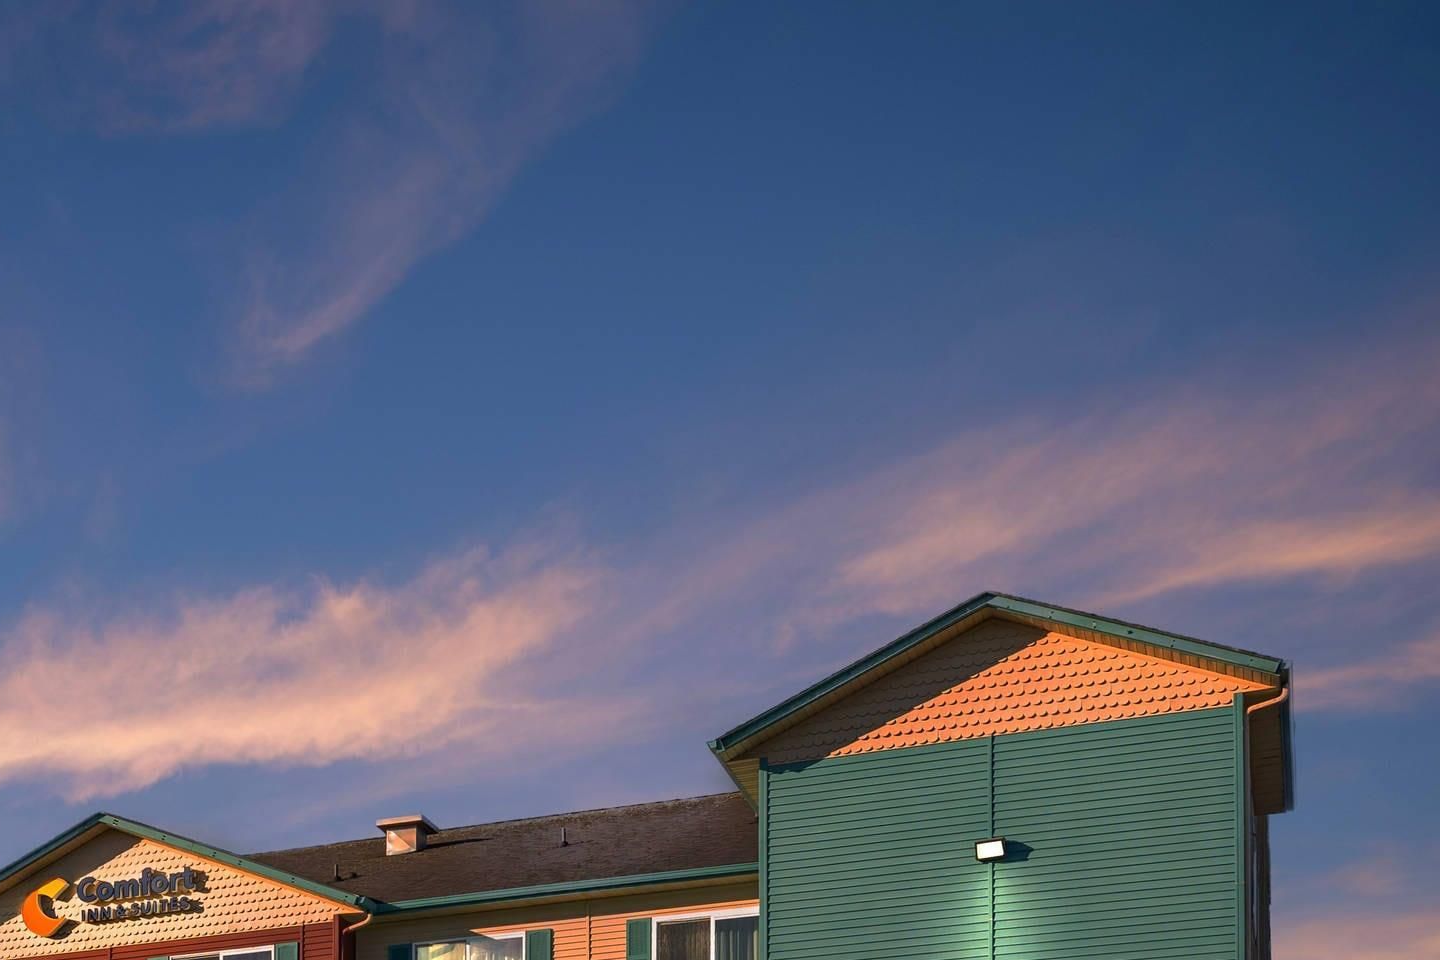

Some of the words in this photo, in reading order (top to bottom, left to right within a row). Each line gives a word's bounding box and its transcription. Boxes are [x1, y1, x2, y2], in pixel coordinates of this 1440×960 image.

[76, 866, 194, 904] Comfort
[81, 905, 112, 922] INN
[114, 903, 128, 920] &
[130, 896, 192, 917] SUITES
